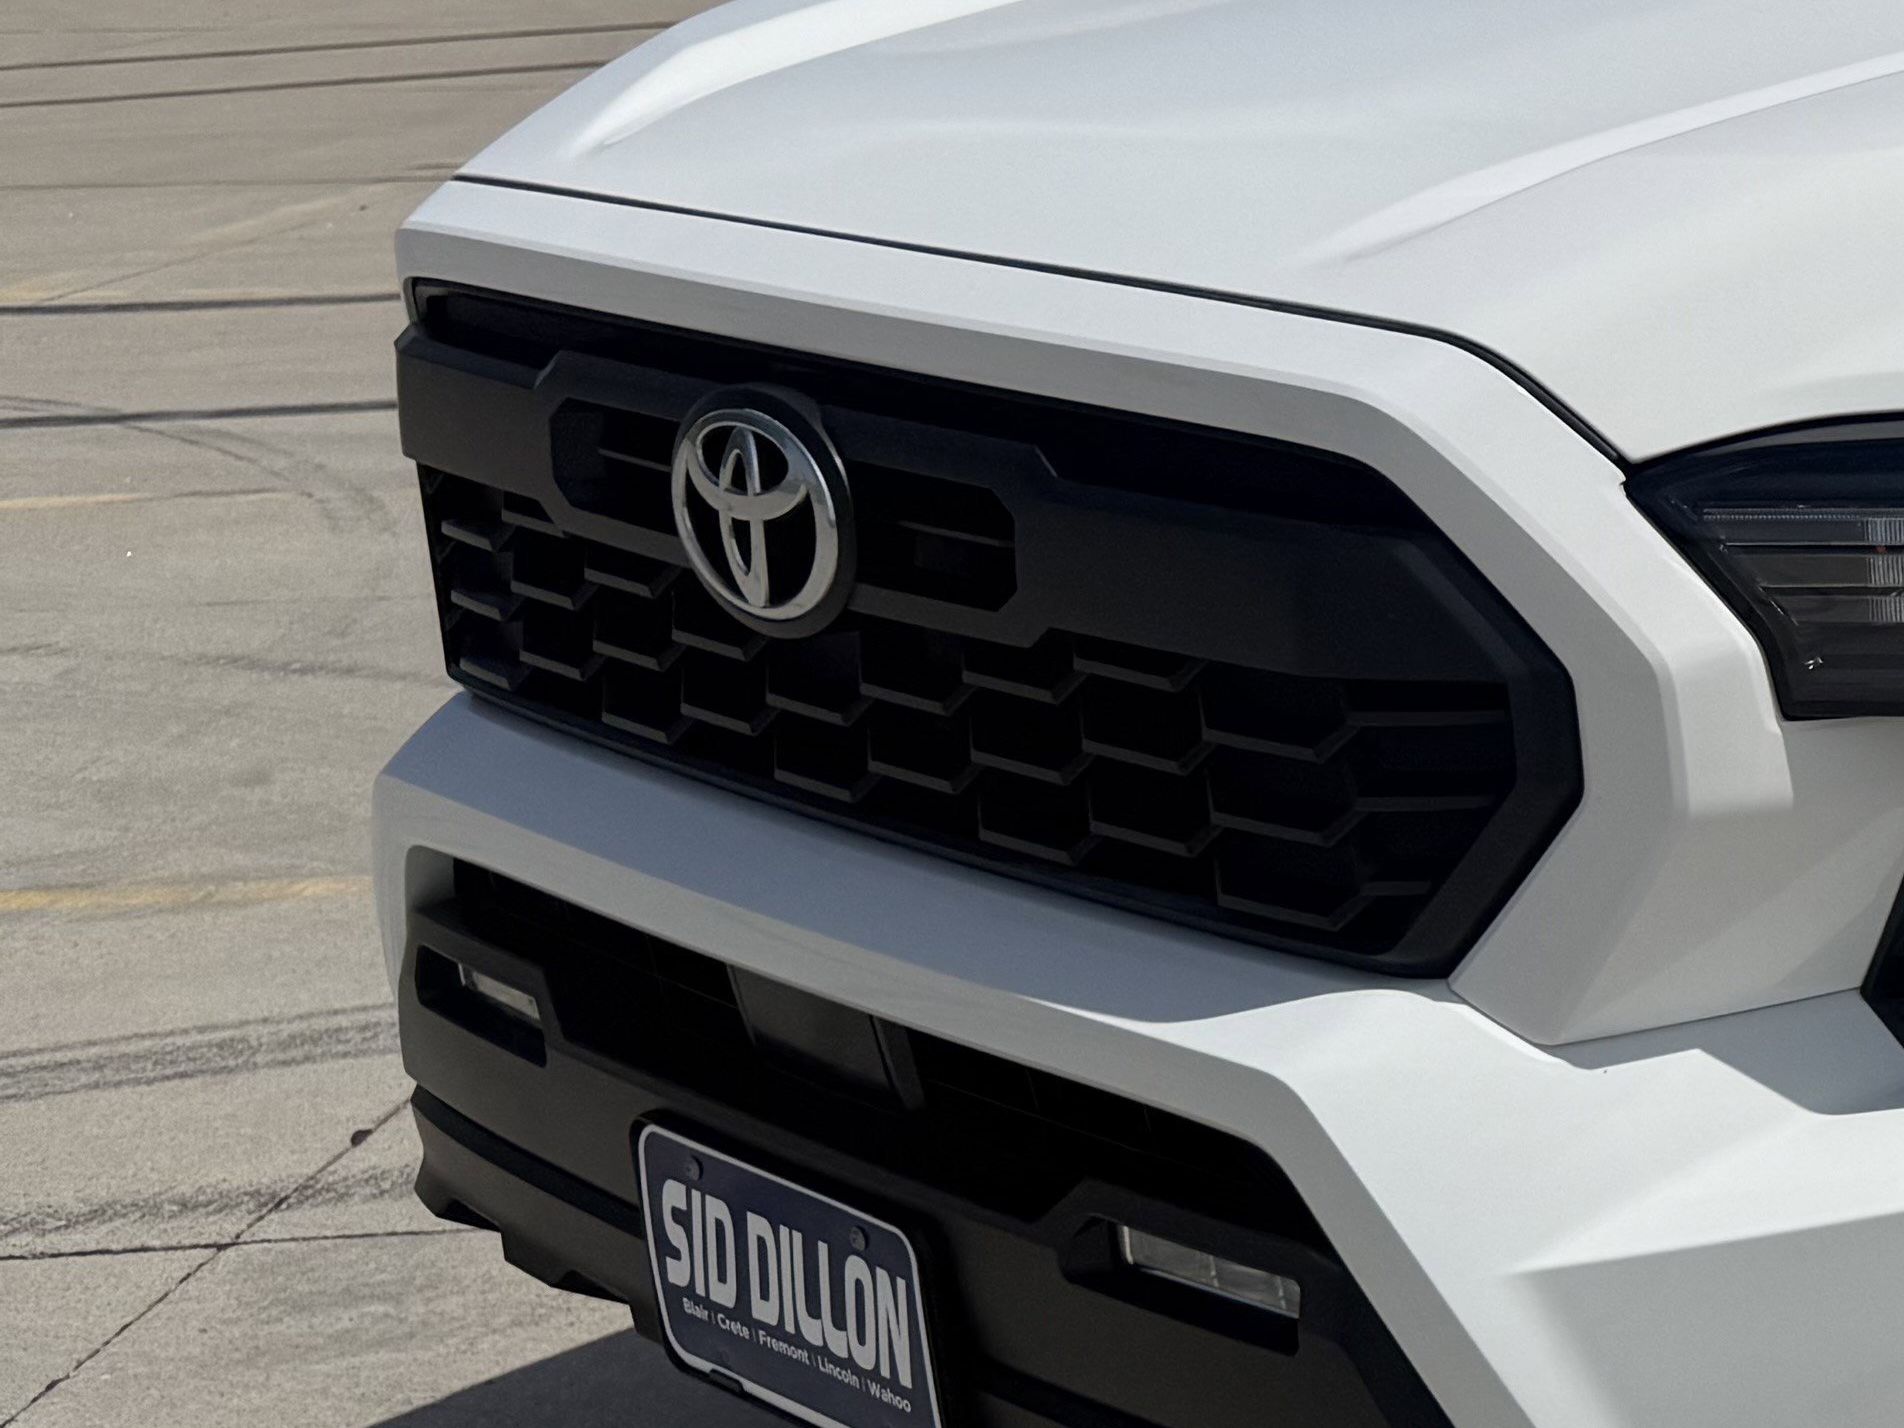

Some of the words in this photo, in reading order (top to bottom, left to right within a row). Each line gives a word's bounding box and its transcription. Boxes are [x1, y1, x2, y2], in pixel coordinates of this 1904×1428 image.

[660, 1177, 738, 1310] SID
[746, 1210, 914, 1390] DILLON
[682, 1297, 710, 1326] Blair
[716, 1312, 751, 1341] Crete
[758, 1329, 811, 1368] Fremont
[817, 1355, 861, 1391] Lincoln
[867, 1377, 913, 1414] Wahoo
